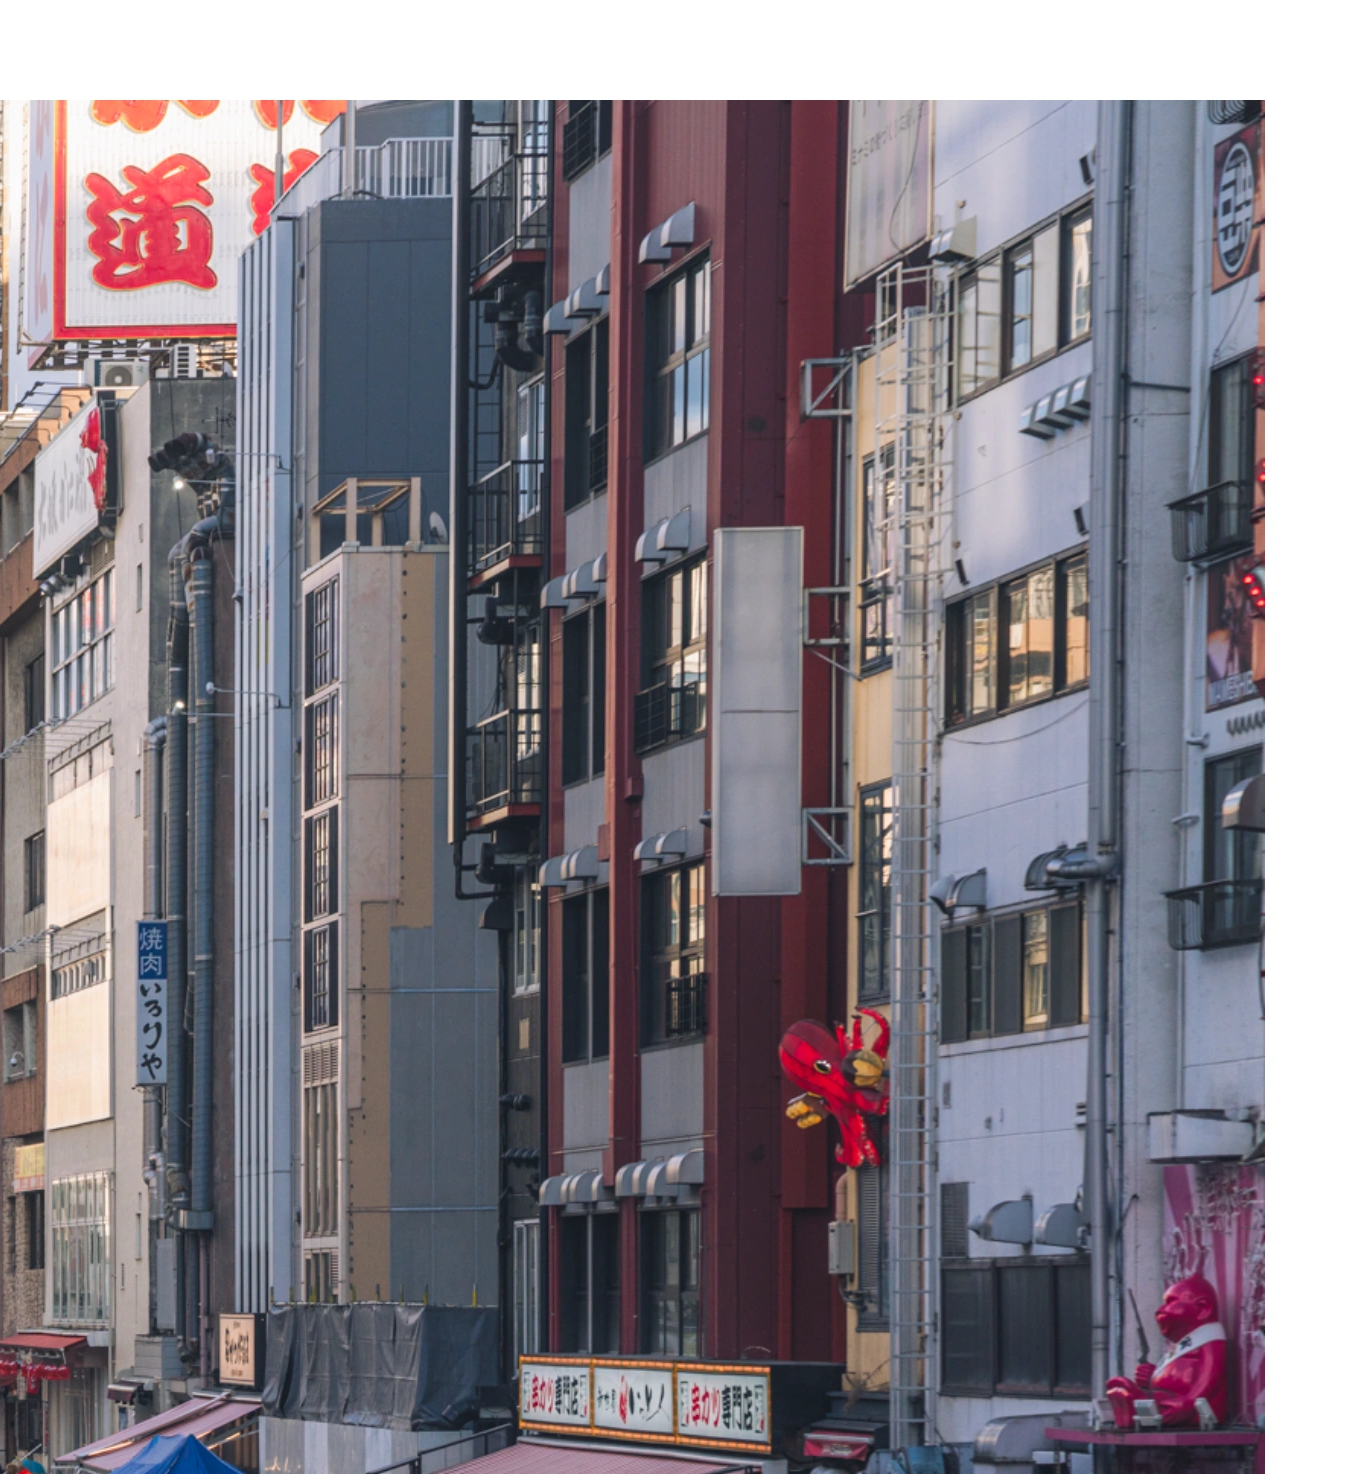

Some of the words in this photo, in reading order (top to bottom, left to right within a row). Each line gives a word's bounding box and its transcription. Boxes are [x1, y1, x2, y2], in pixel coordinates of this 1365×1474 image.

[86, 152, 218, 292] 道
[138, 927, 165, 976] 焼肉
[138, 982, 165, 1081] いろりや
